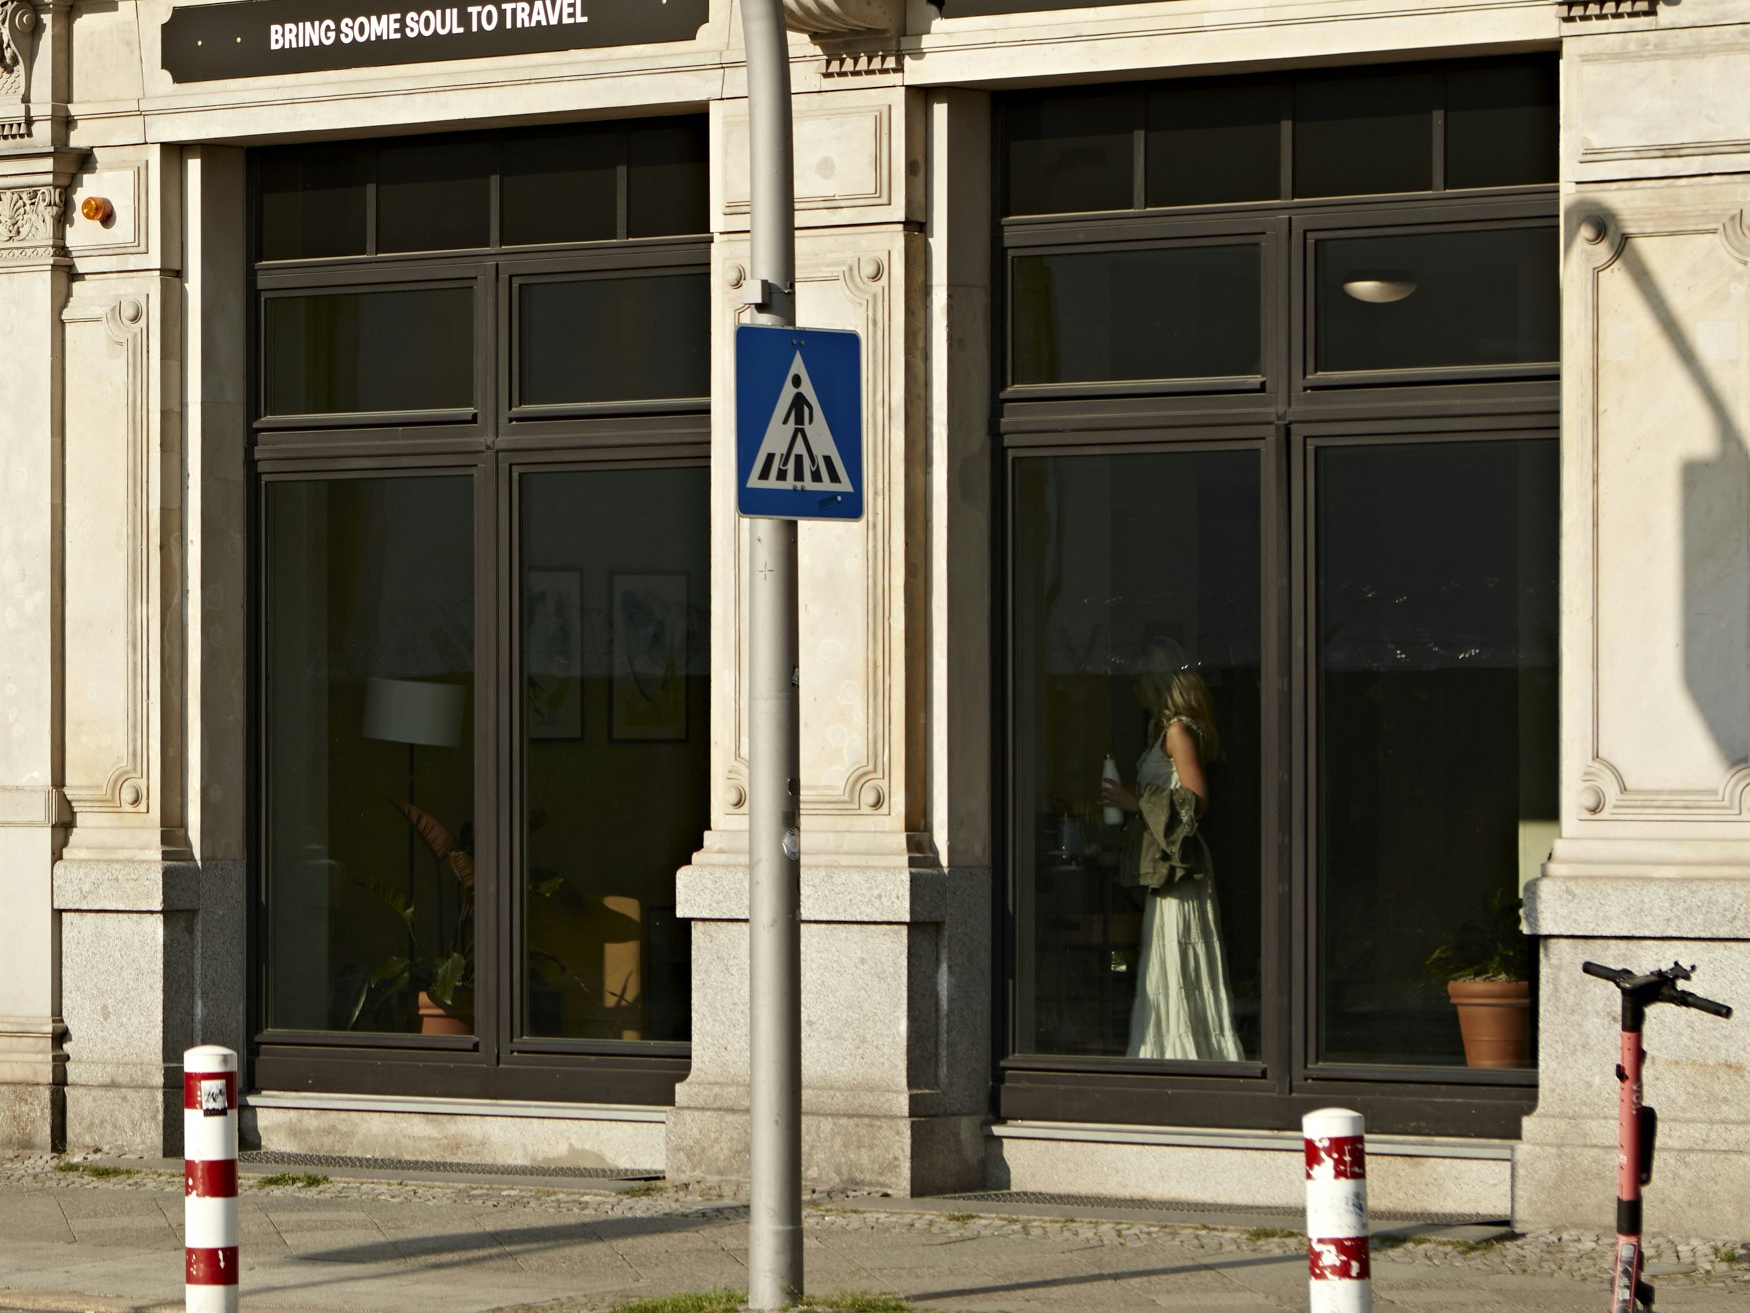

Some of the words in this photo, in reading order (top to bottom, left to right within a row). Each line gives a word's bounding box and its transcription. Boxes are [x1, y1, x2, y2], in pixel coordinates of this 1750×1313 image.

[270, 19, 336, 51] BRING
[339, 13, 401, 44] SOME
[405, 7, 465, 38] SOUL
[467, 4, 498, 32] TO
